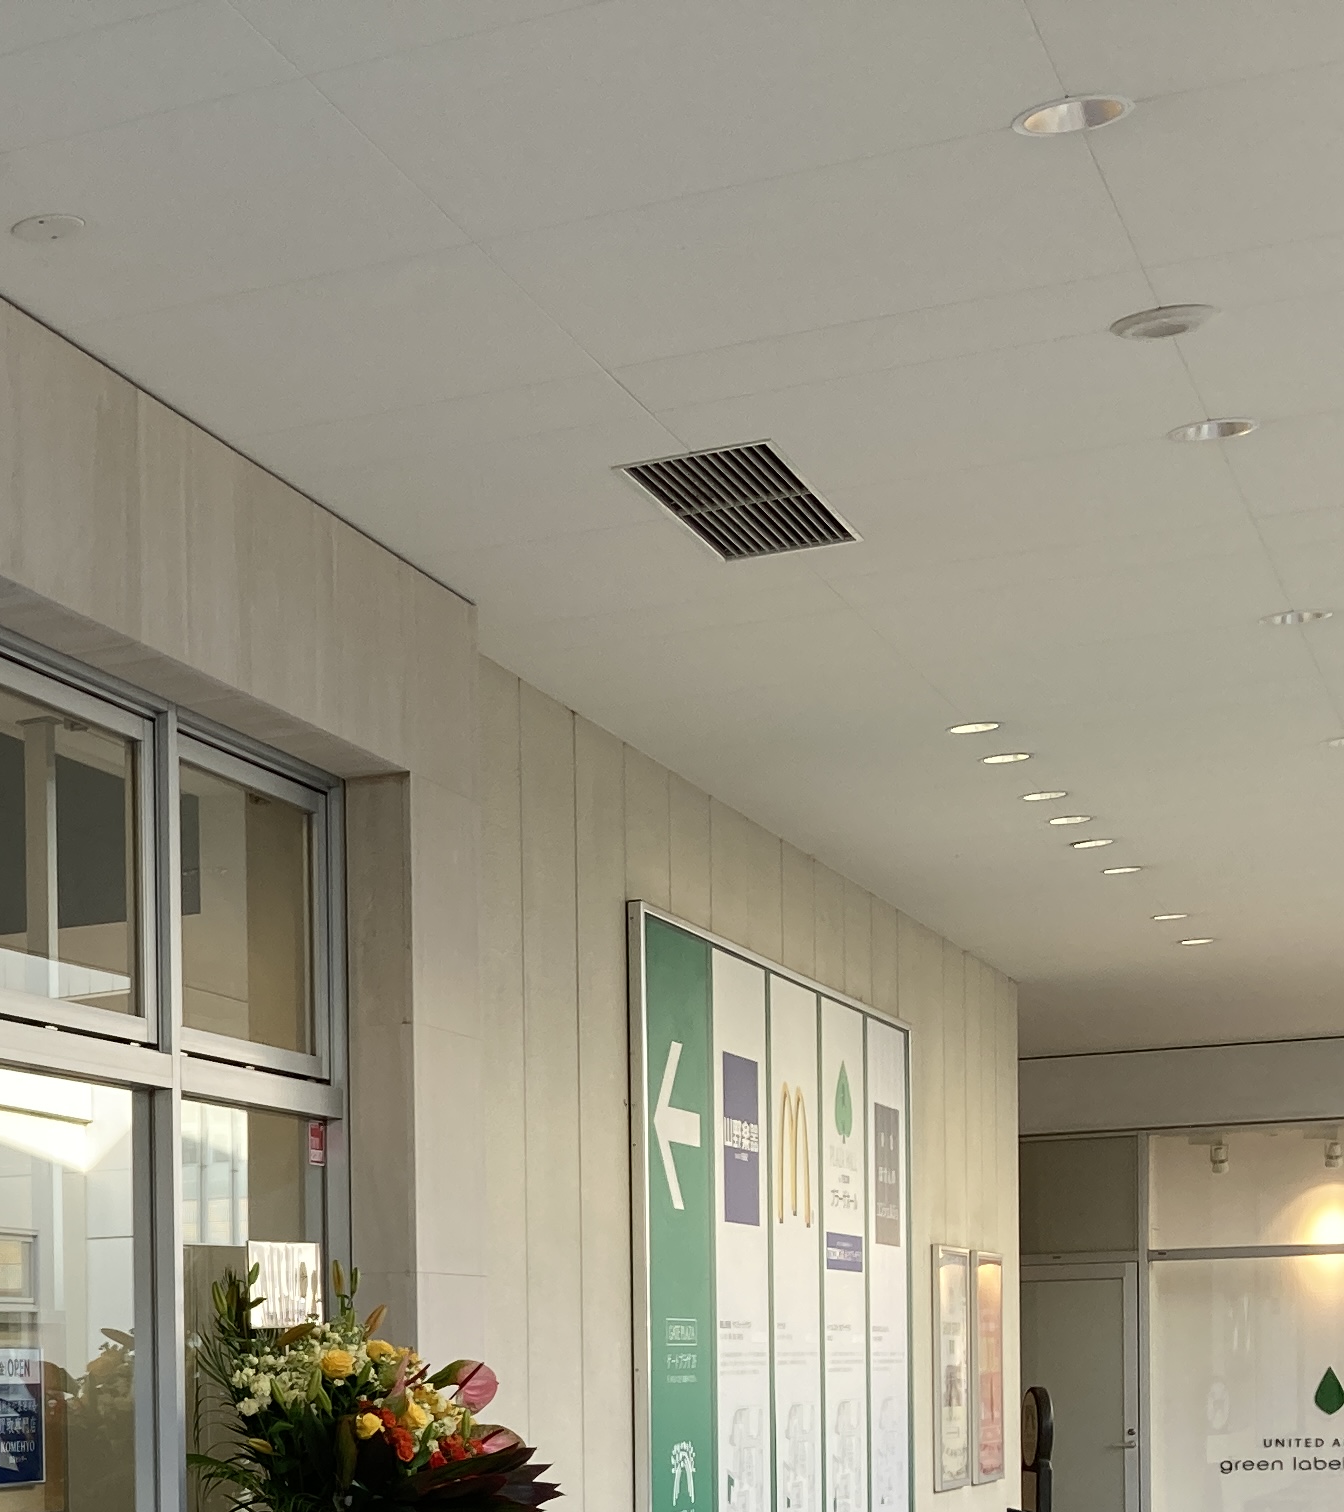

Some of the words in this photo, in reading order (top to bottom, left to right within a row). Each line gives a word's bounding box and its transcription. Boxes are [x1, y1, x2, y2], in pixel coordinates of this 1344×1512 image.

[0, 1440, 36, 1454] KOMEHYO
[1263, 1438, 1325, 1448] UNITED
[1220, 1459, 1284, 1475] green
